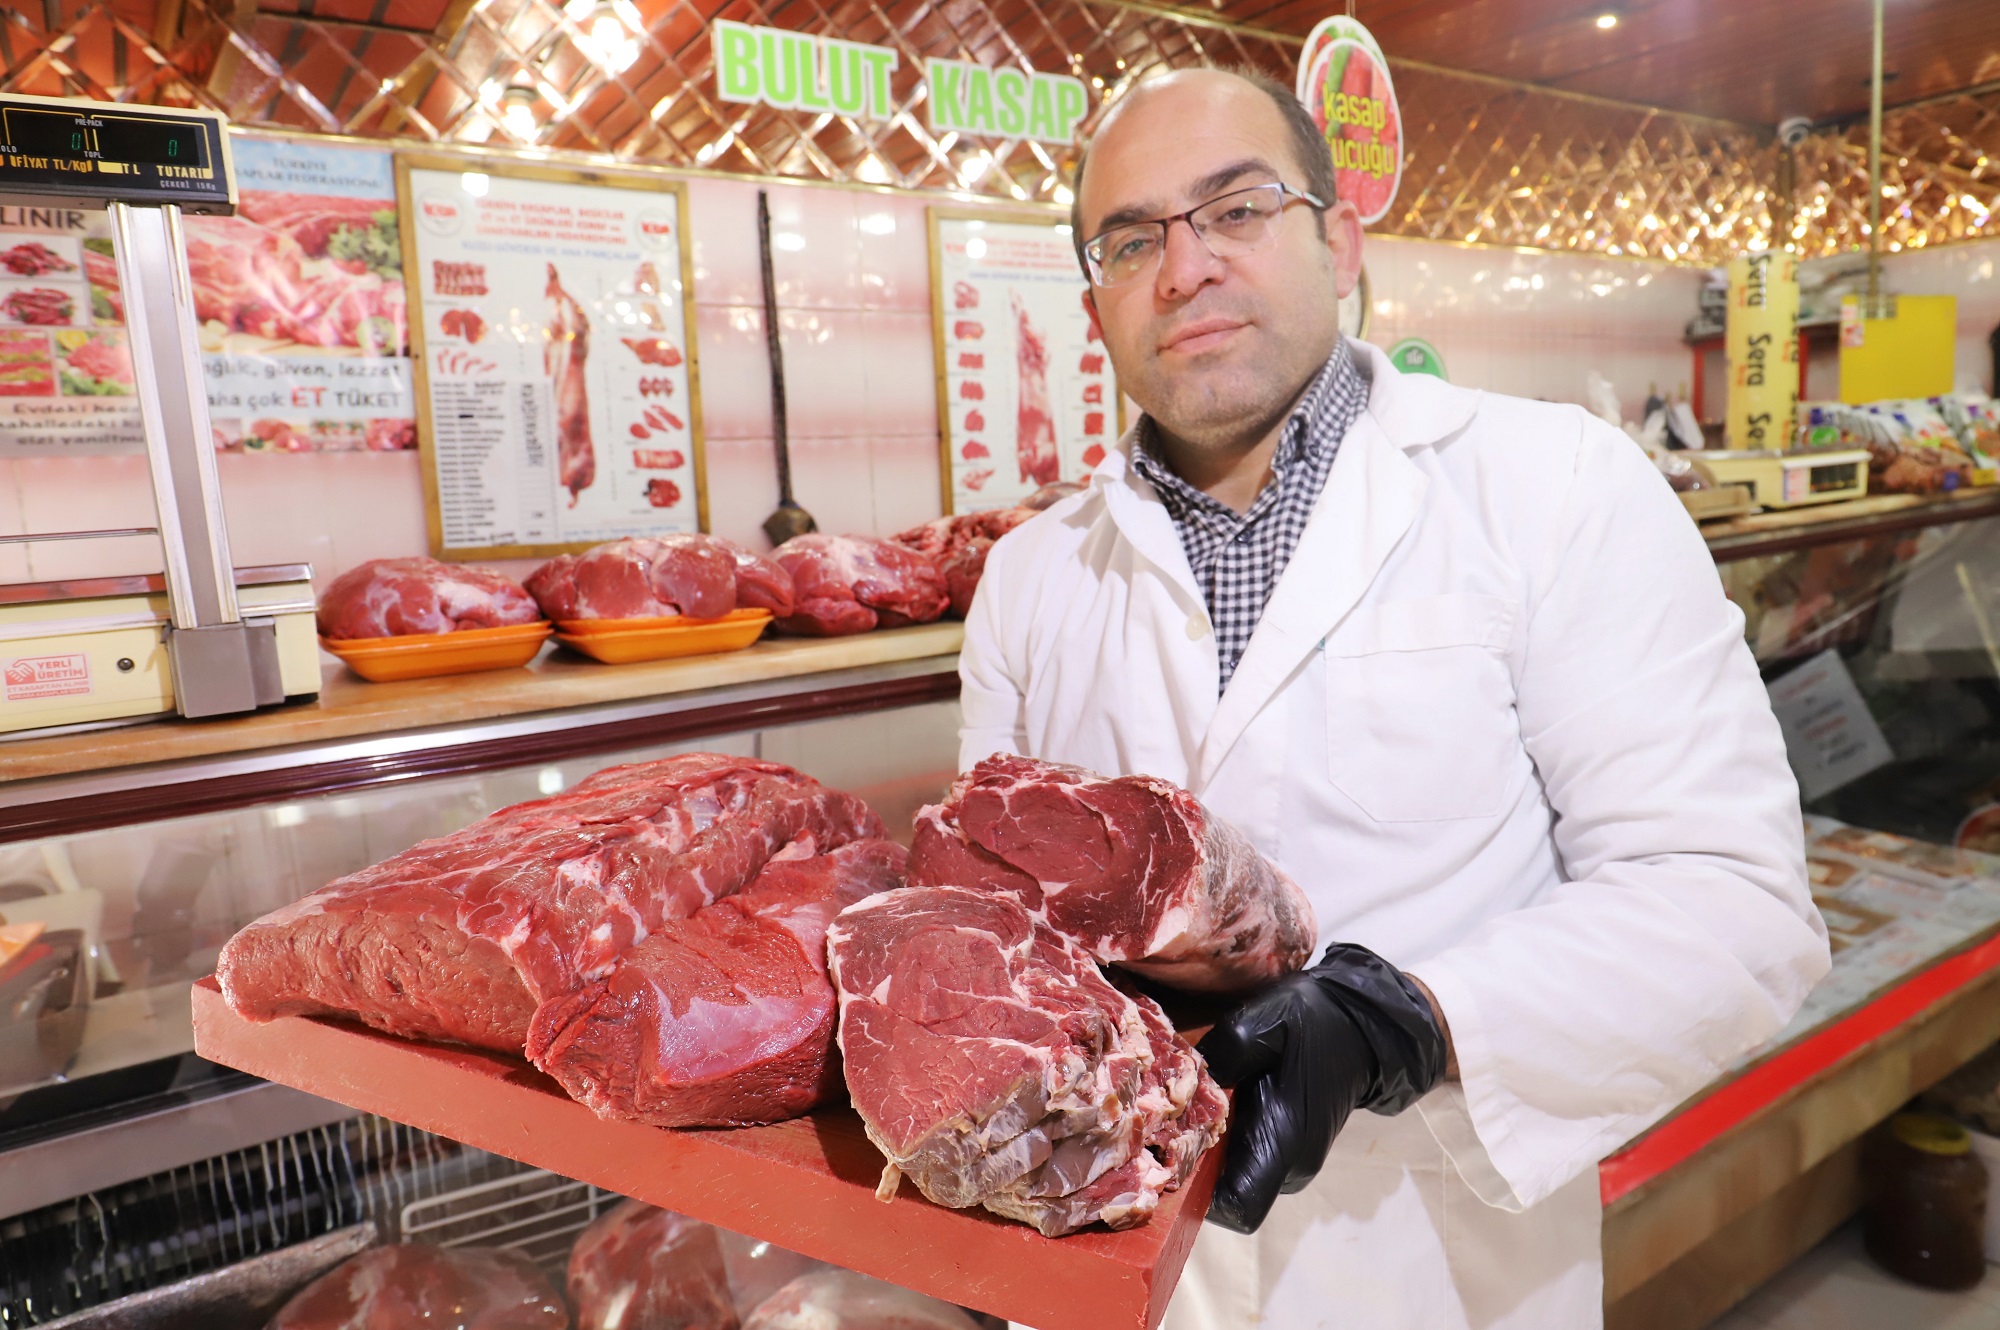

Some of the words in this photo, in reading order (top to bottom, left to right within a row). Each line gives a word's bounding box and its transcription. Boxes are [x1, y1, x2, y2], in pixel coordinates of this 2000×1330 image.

[721, 26, 893, 119] BULUT
[932, 63, 1085, 140] KASAP
[1322, 82, 1386, 133] kasap
[75, 118, 103, 127] PRE-PACK
[16, 155, 48, 169] FİYAT
[53, 159, 88, 173] TL/Kg
[157, 165, 203, 180] TUTARI
[1748, 333, 1771, 387] Sera
[264, 361, 332, 379] güven,
[339, 362, 400, 377] lezzet
[247, 393, 285, 411] çok
[291, 387, 327, 408] ET
[335, 390, 402, 408] TÜKET
[37, 659, 72, 669] YERLİ
[37, 667, 83, 680] ÜRETİM
